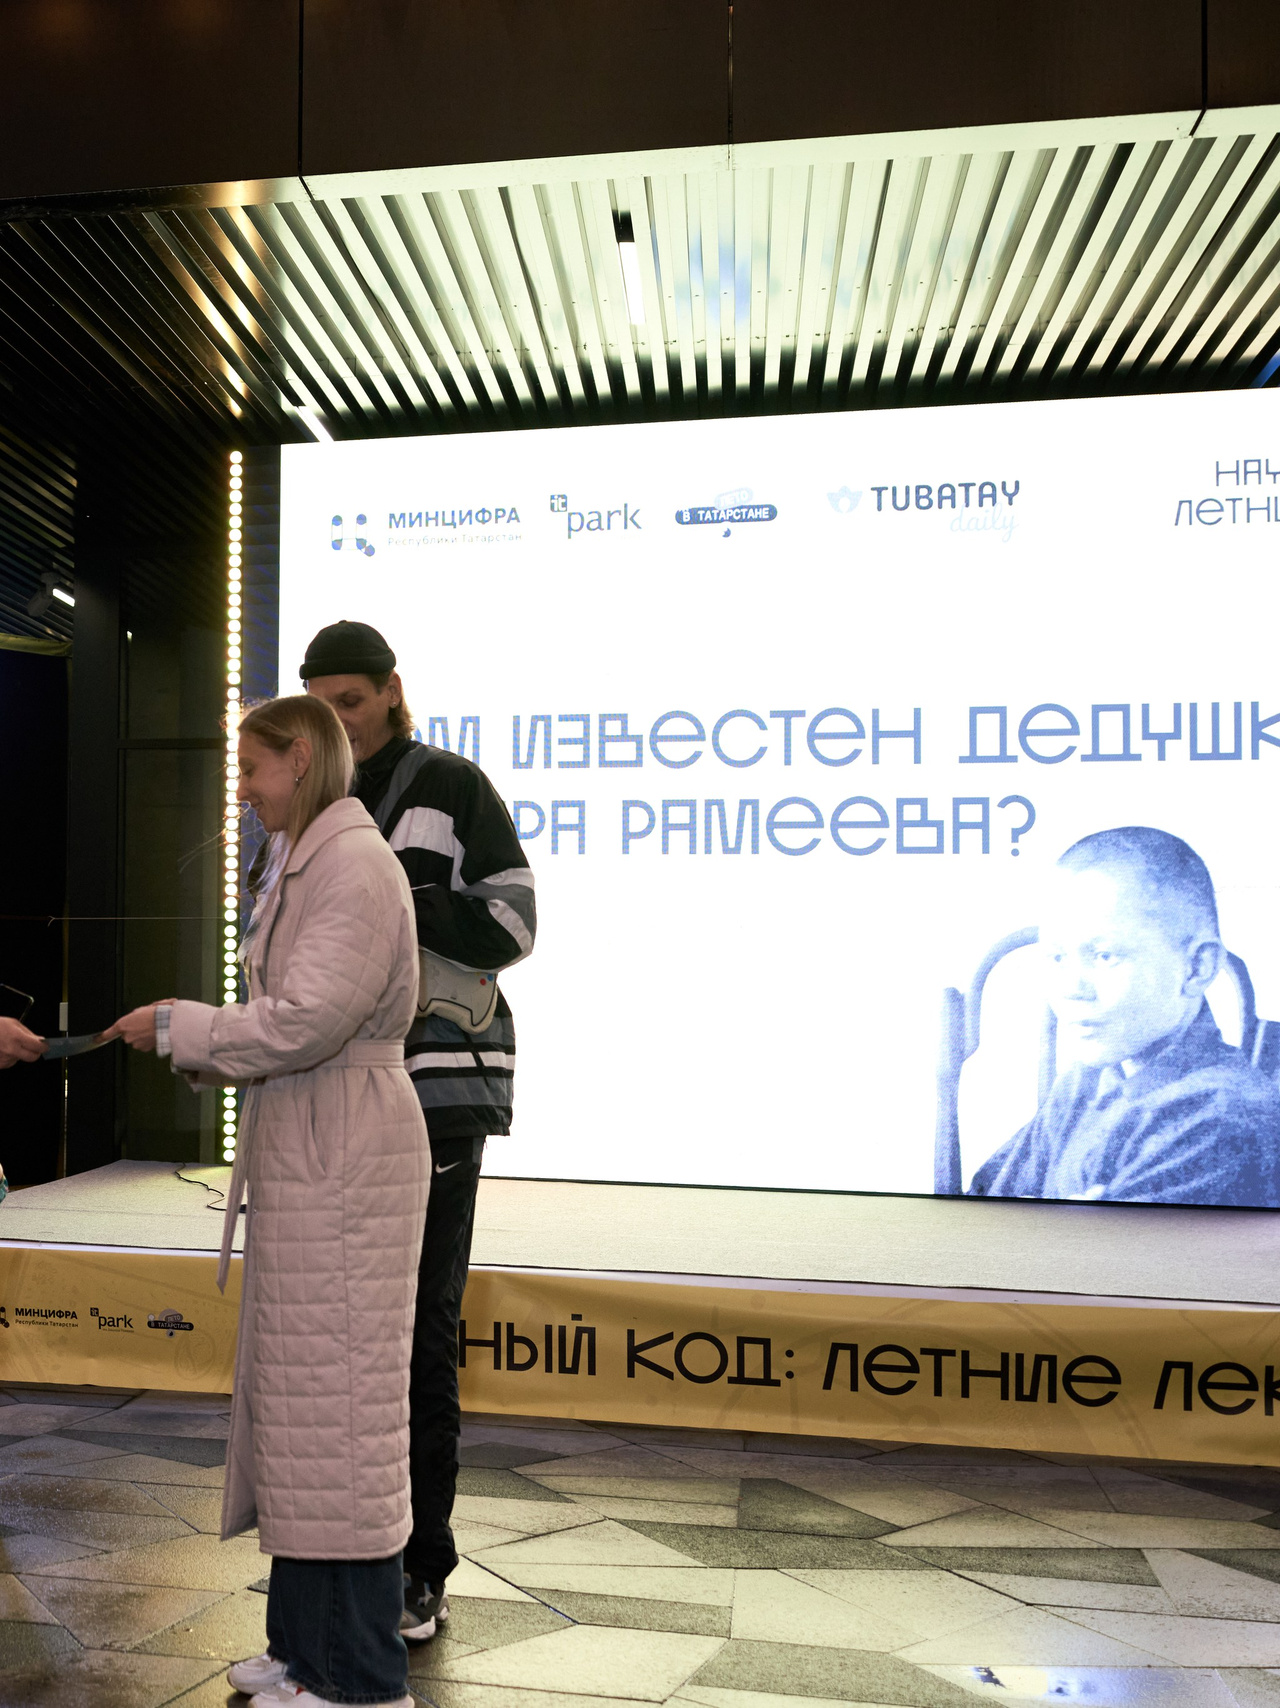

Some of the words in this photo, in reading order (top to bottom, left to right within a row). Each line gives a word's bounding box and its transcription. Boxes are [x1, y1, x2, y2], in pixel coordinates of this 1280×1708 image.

[871, 480, 1019, 511] TUBATAY
[389, 508, 520, 528] МИНЦИФРА
[567, 503, 642, 539] park
[682, 509, 691, 522] В
[697, 507, 770, 522] ТАТАРСТАНЕ
[950, 502, 1019, 543] daily
[15, 1307, 78, 1320] МИНЦИФРА
[15, 1318, 49, 1326] Республики
[98, 1315, 134, 1330] park
[157, 1321, 191, 1330] ТАТАРСТАНЕ
